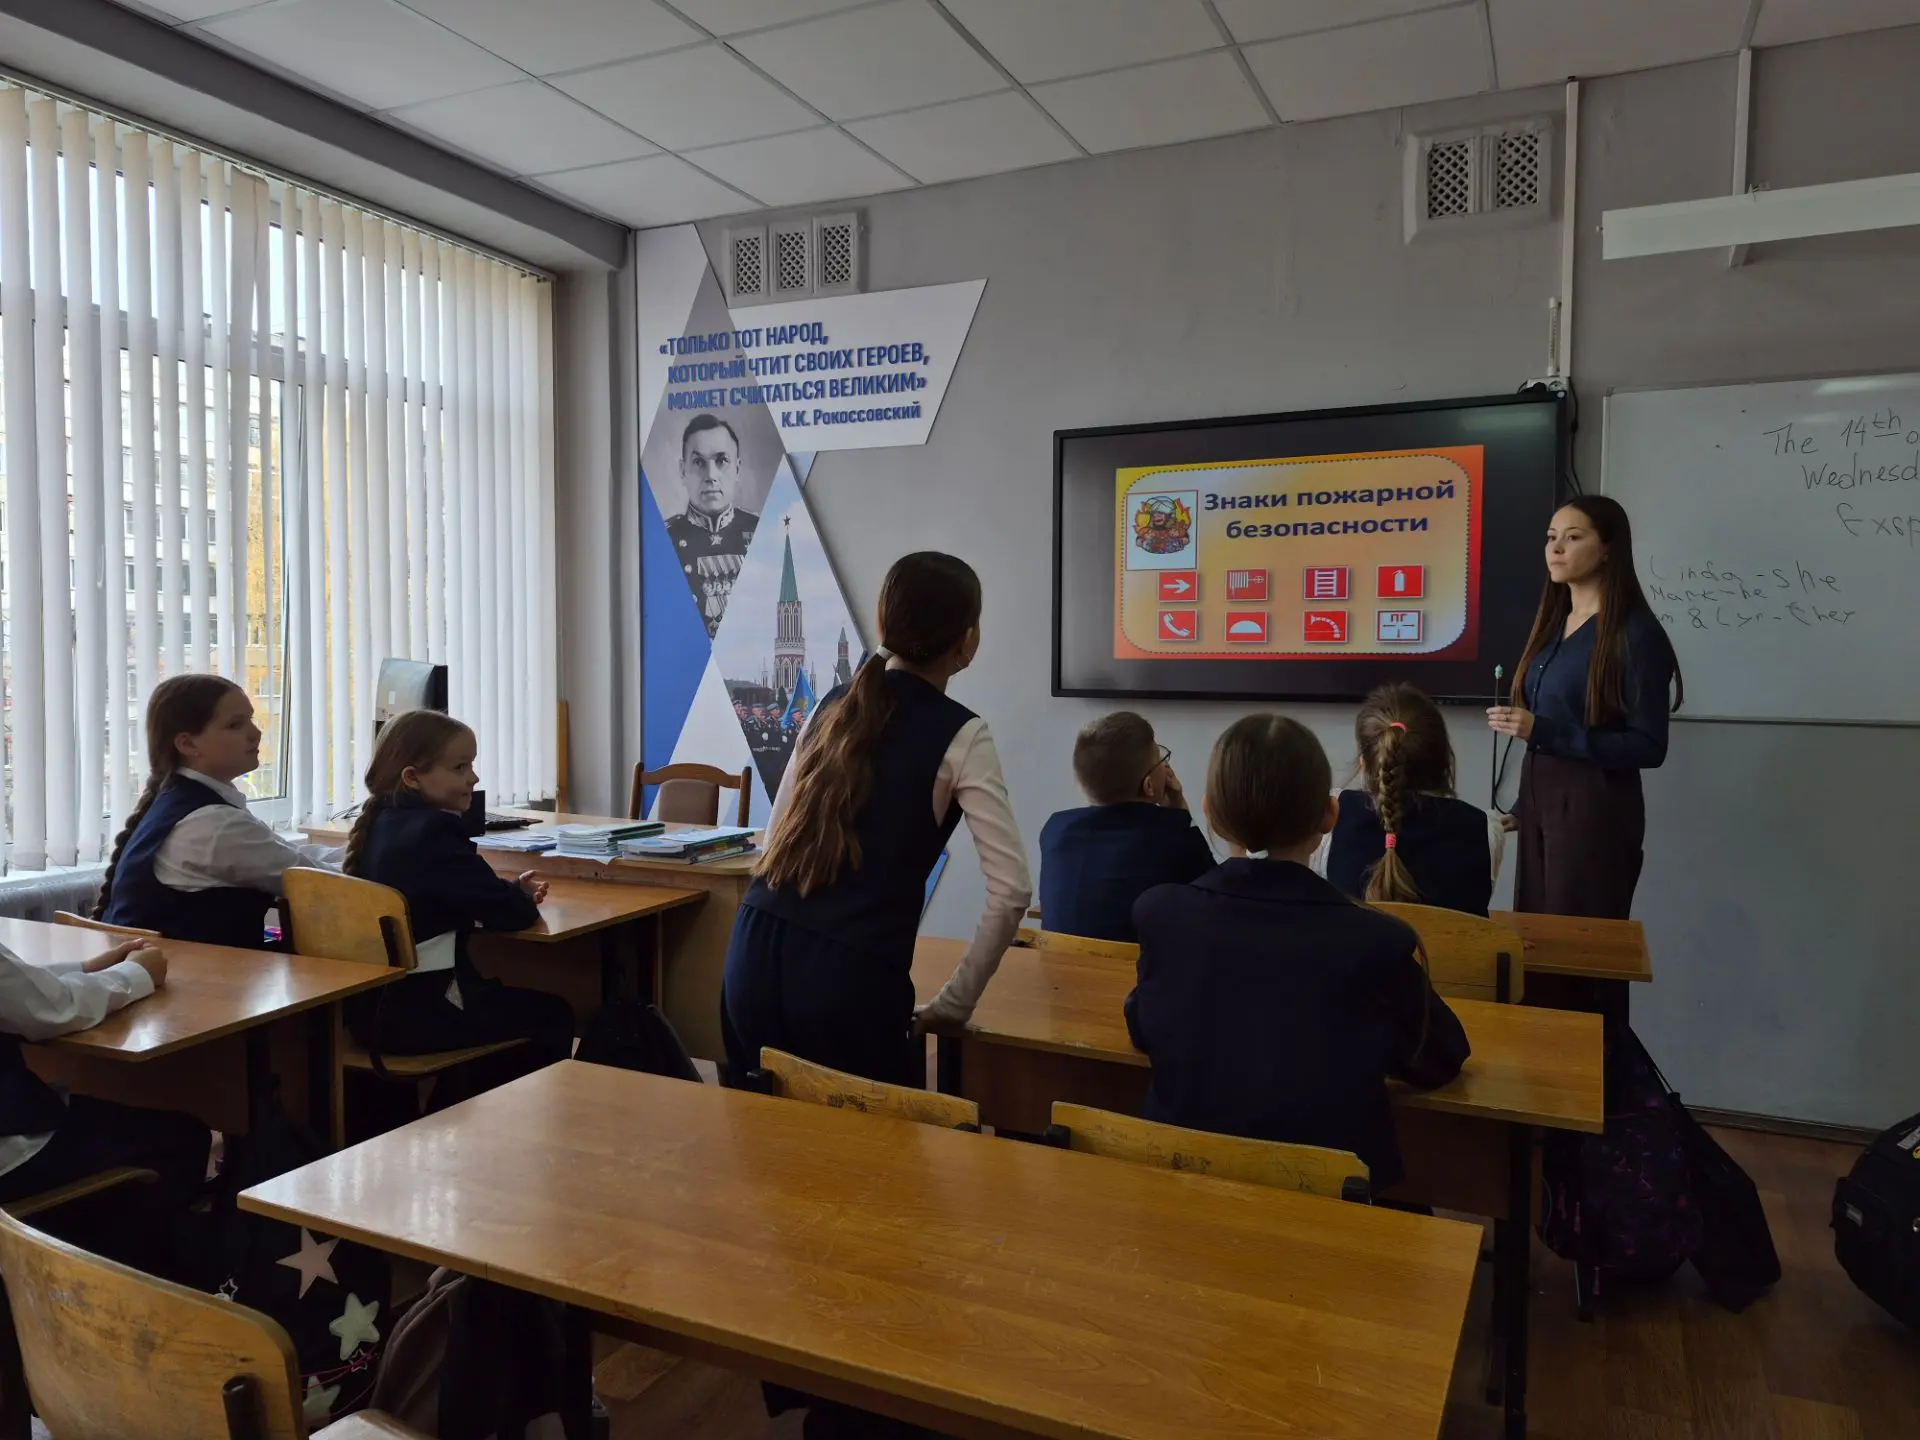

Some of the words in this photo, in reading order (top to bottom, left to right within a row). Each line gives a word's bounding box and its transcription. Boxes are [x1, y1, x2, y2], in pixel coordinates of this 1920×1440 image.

[659, 331, 731, 356] «ТОЛЬКО
[733, 328, 763, 349] ТОТ
[766, 321, 830, 346] НАРОД,
[668, 355, 746, 384] КОТОРЫЙ
[748, 355, 792, 377] ЧТИТ
[794, 348, 855, 374] СВОИХ
[857, 342, 931, 367] ГЕРОЕВ,
[667, 388, 728, 411] МОЖЕТ
[729, 379, 826, 407] СЧИТАТЬСЯ
[829, 371, 928, 398] ВЕЛИКИМ»
[781, 410, 811, 428] К.К.
[813, 400, 922, 426] Рокоссовский
[1763, 422, 1819, 455] The
[1801, 449, 1920, 490] Wednesd
[1204, 492, 1288, 511] Знаки
[1297, 479, 1455, 507] пожарной
[1226, 517, 1429, 539] безопасности
[1390, 613, 1408, 622] ПГ
